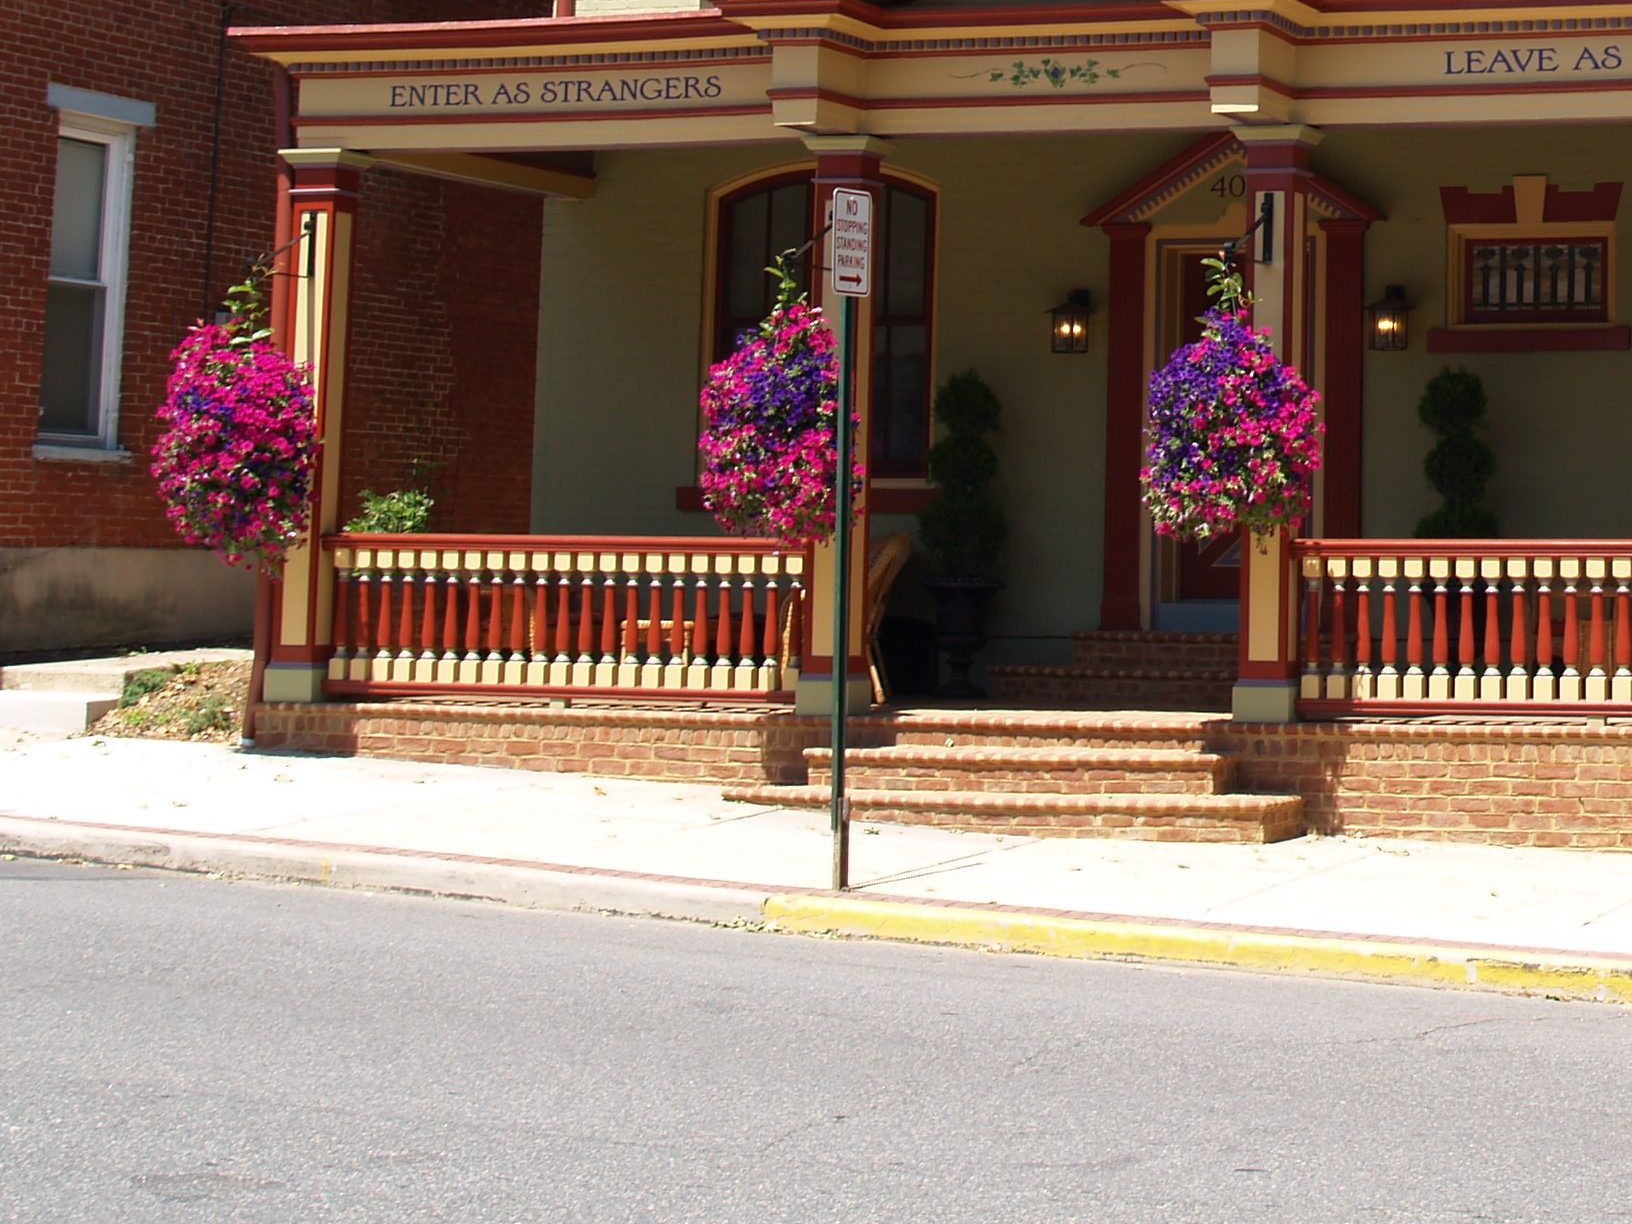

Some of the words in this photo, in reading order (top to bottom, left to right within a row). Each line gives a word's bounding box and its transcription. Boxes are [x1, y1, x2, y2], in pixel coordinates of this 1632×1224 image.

[1443, 47, 1560, 75] LEAVE
[1572, 45, 1623, 72] AS
[389, 83, 484, 108] ENTER
[490, 82, 531, 105] AS
[540, 75, 723, 103] STRANGERS
[846, 199, 858, 216] NO
[836, 218, 868, 236] STOPPING
[836, 236, 868, 253] STANDING
[837, 254, 866, 270] PARKING
